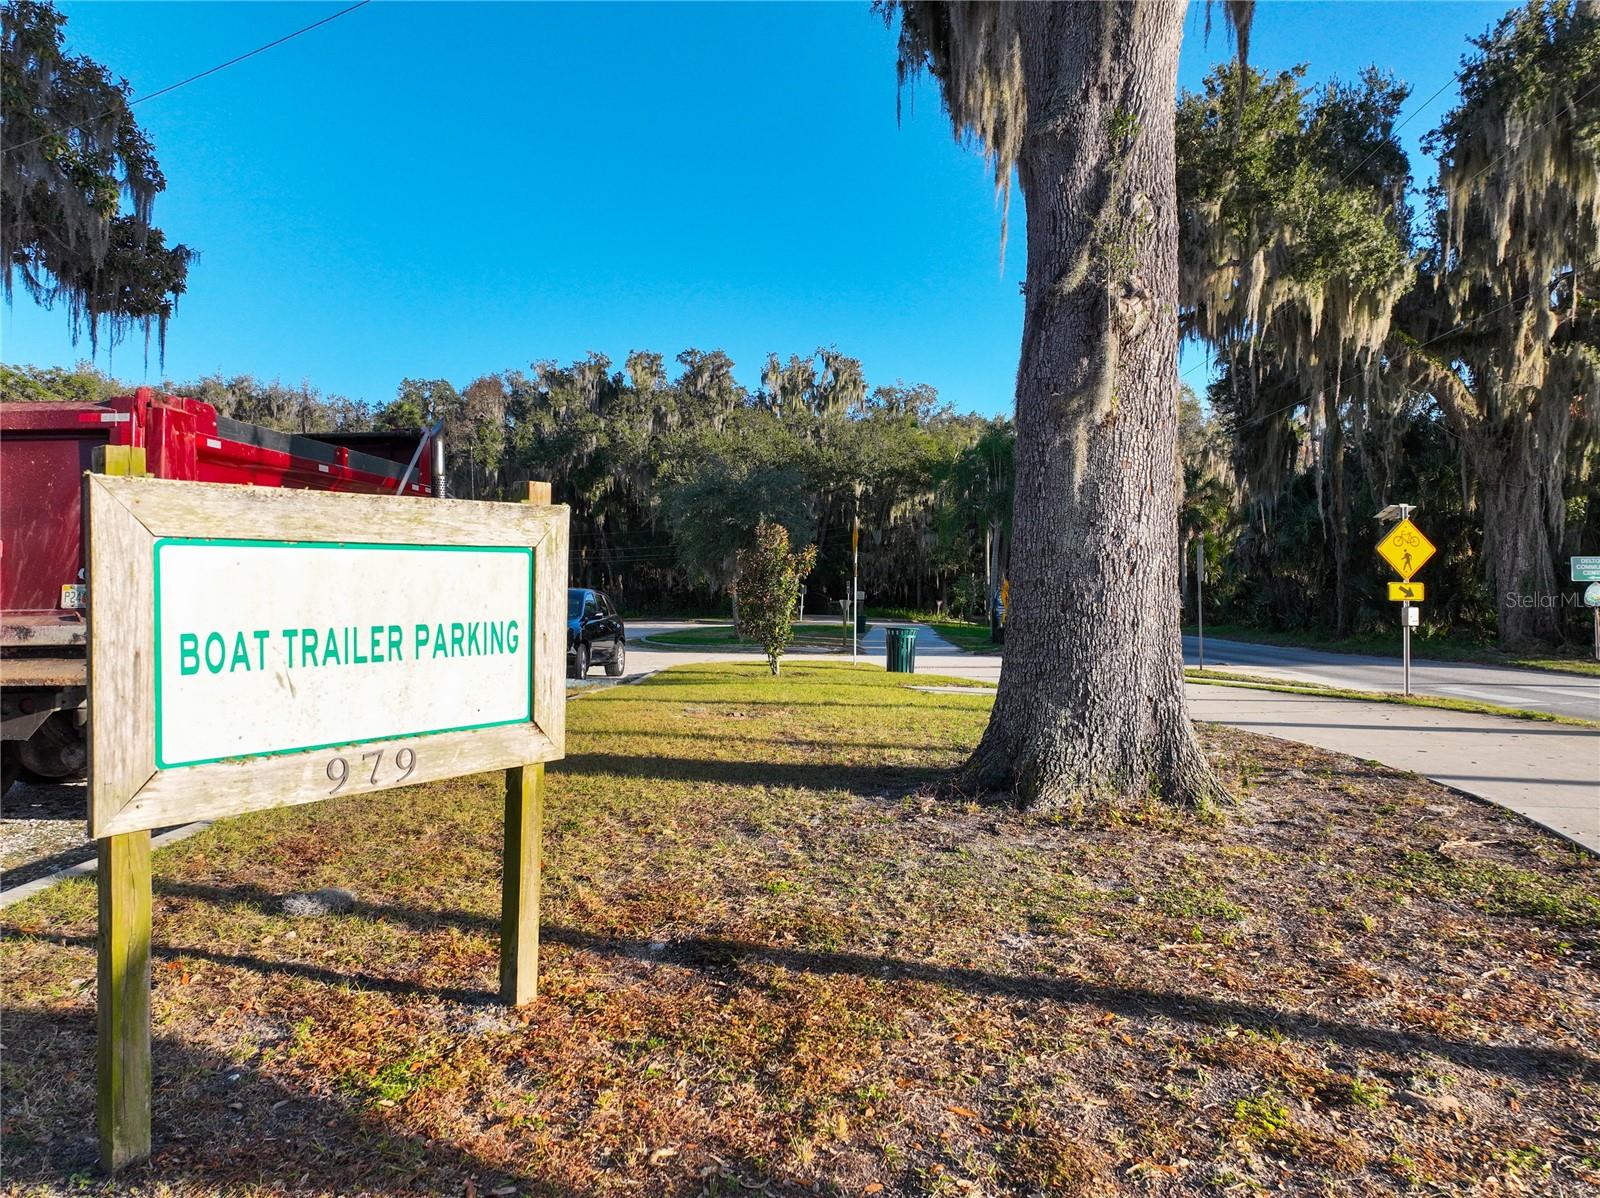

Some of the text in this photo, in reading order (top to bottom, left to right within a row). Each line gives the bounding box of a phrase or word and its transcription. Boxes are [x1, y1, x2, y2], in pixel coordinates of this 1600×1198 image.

[179, 619, 520, 676] BOAT TRAILER PARKING
[326, 747, 417, 796] 979
